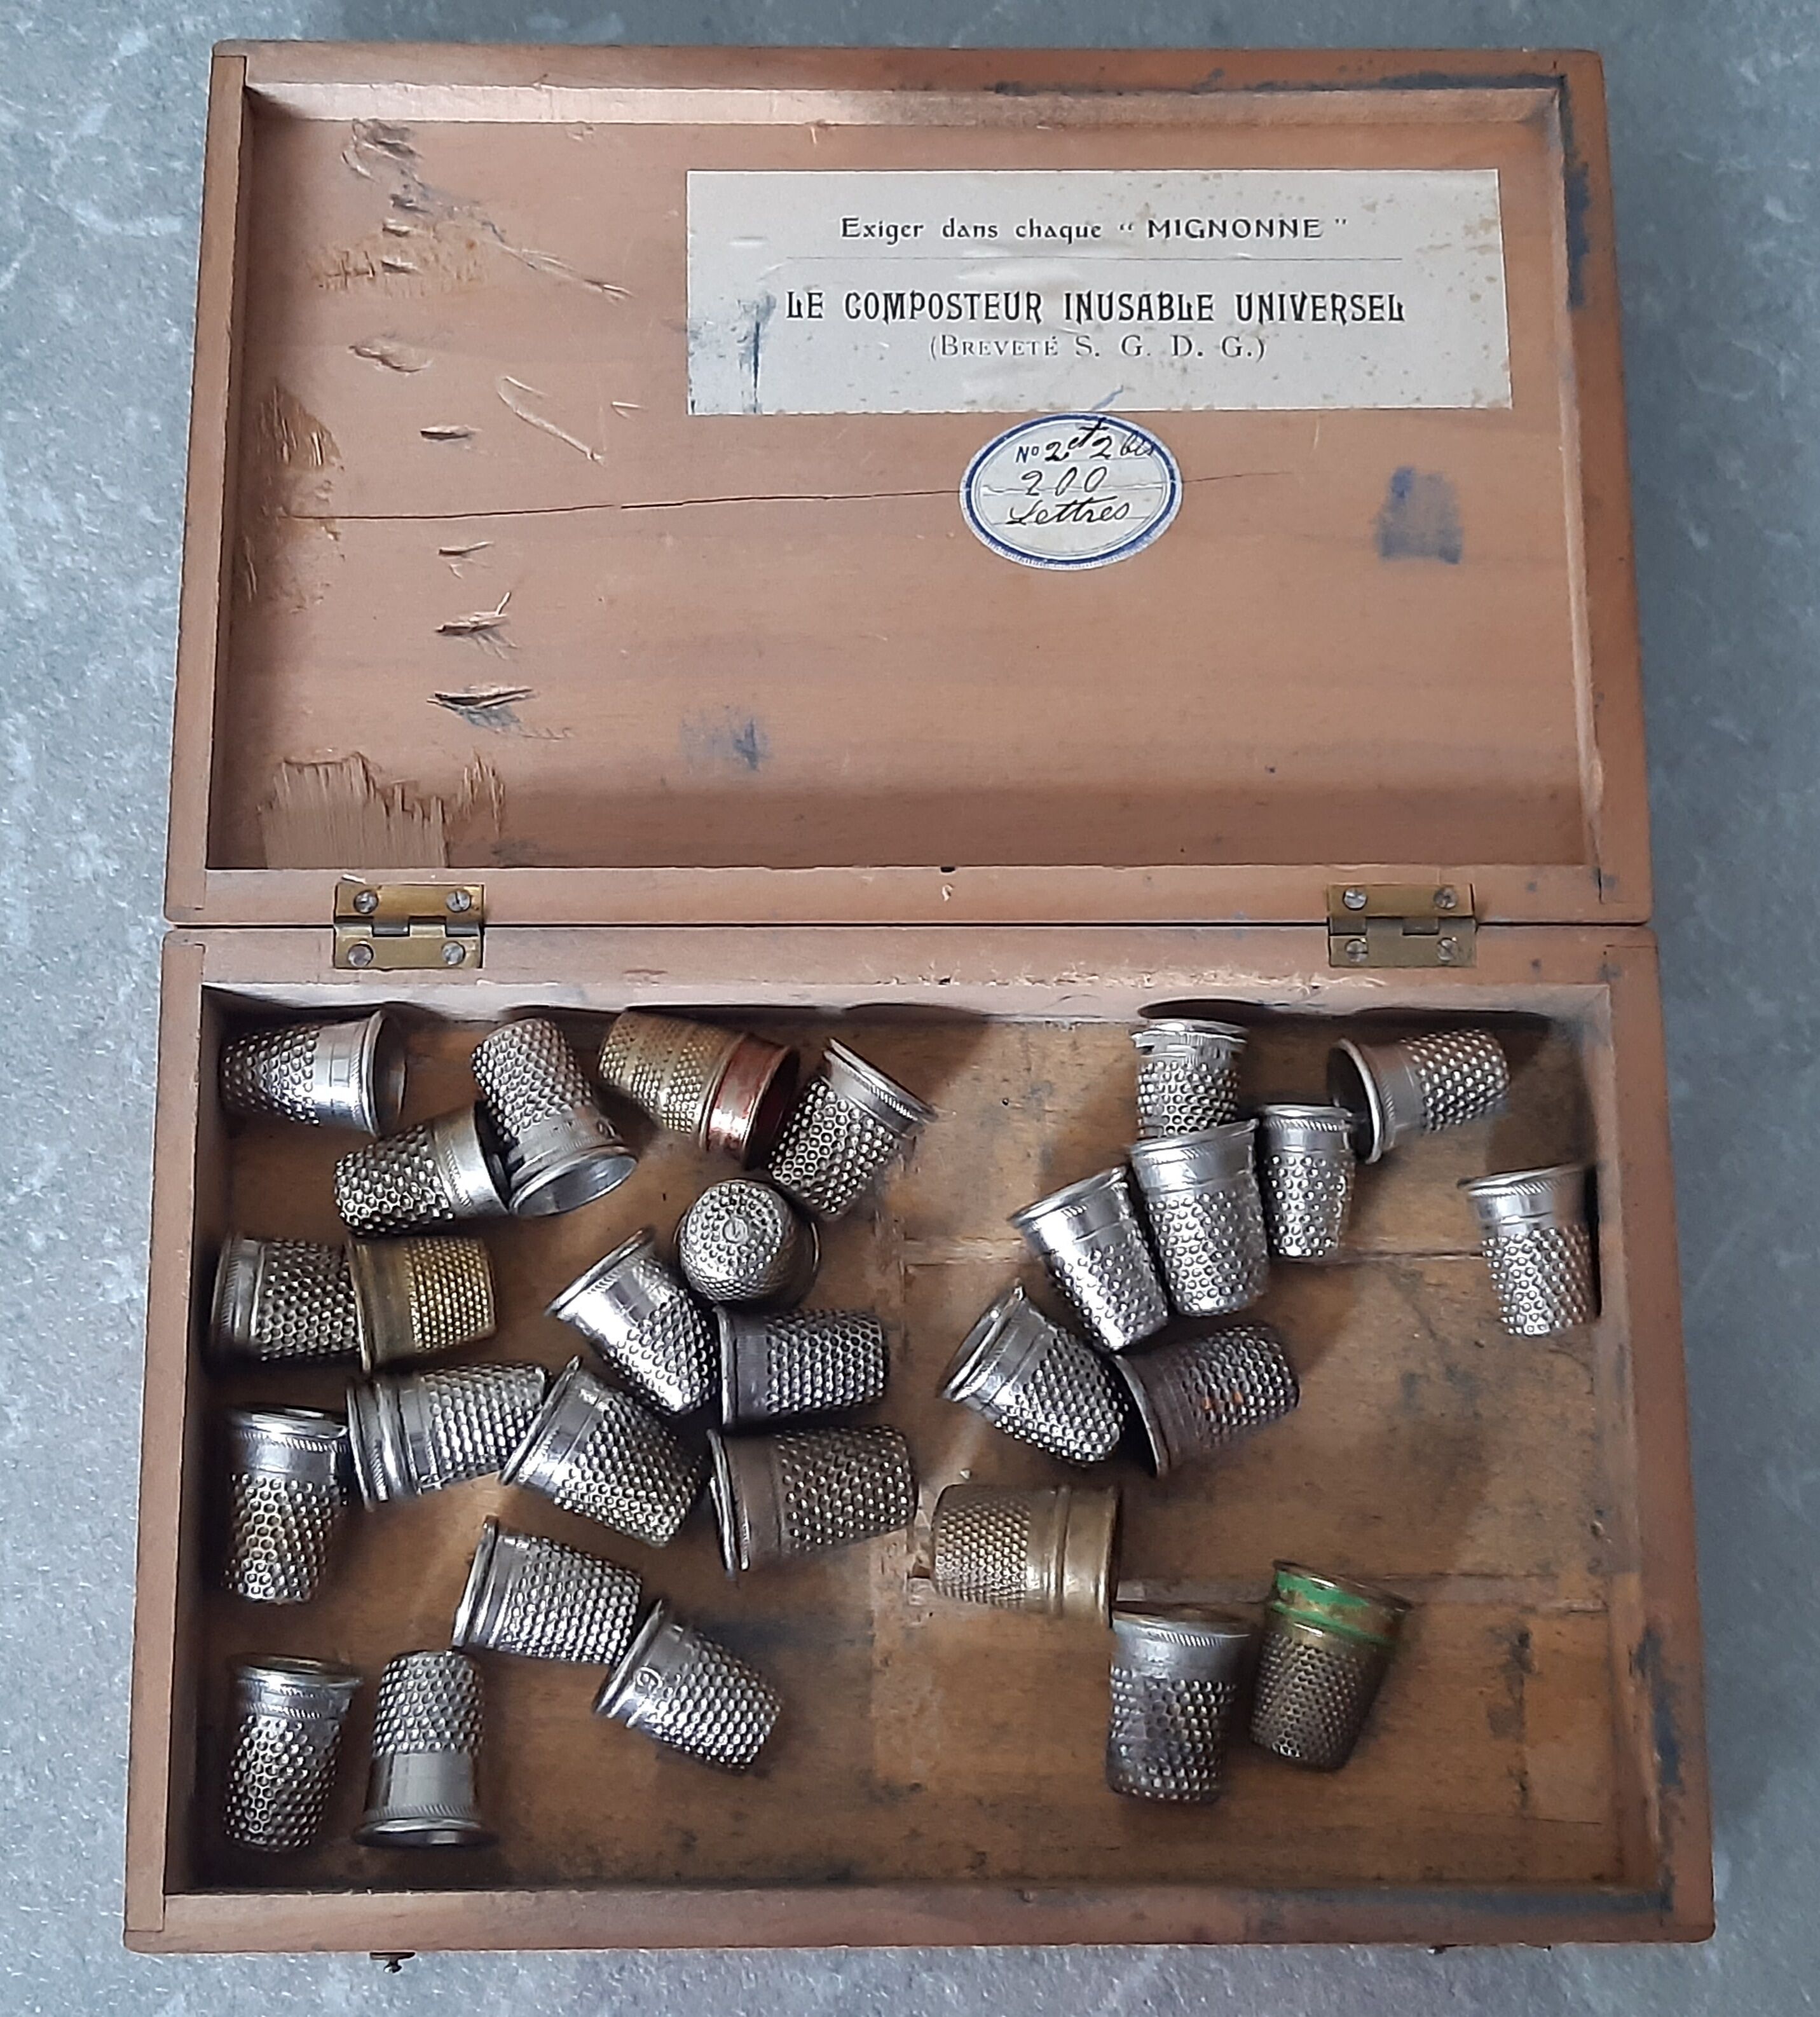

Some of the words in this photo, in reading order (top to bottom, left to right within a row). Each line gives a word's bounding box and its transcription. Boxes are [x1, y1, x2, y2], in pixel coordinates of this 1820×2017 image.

[841, 217, 924, 245] Exiger
[943, 217, 998, 238] dans
[1016, 218, 1102, 245] chaque
[786, 291, 823, 319] LE
[845, 290, 1043, 325] COMPOSTEUR
[1064, 290, 1214, 325] INUSABLE
[1235, 291, 1406, 325] UNIVERSEL
[1074, 335, 1100, 357] S.
[1121, 335, 1152, 357] G.
[1172, 335, 1203, 357] D.
[1221, 336, 1266, 362] G.)
